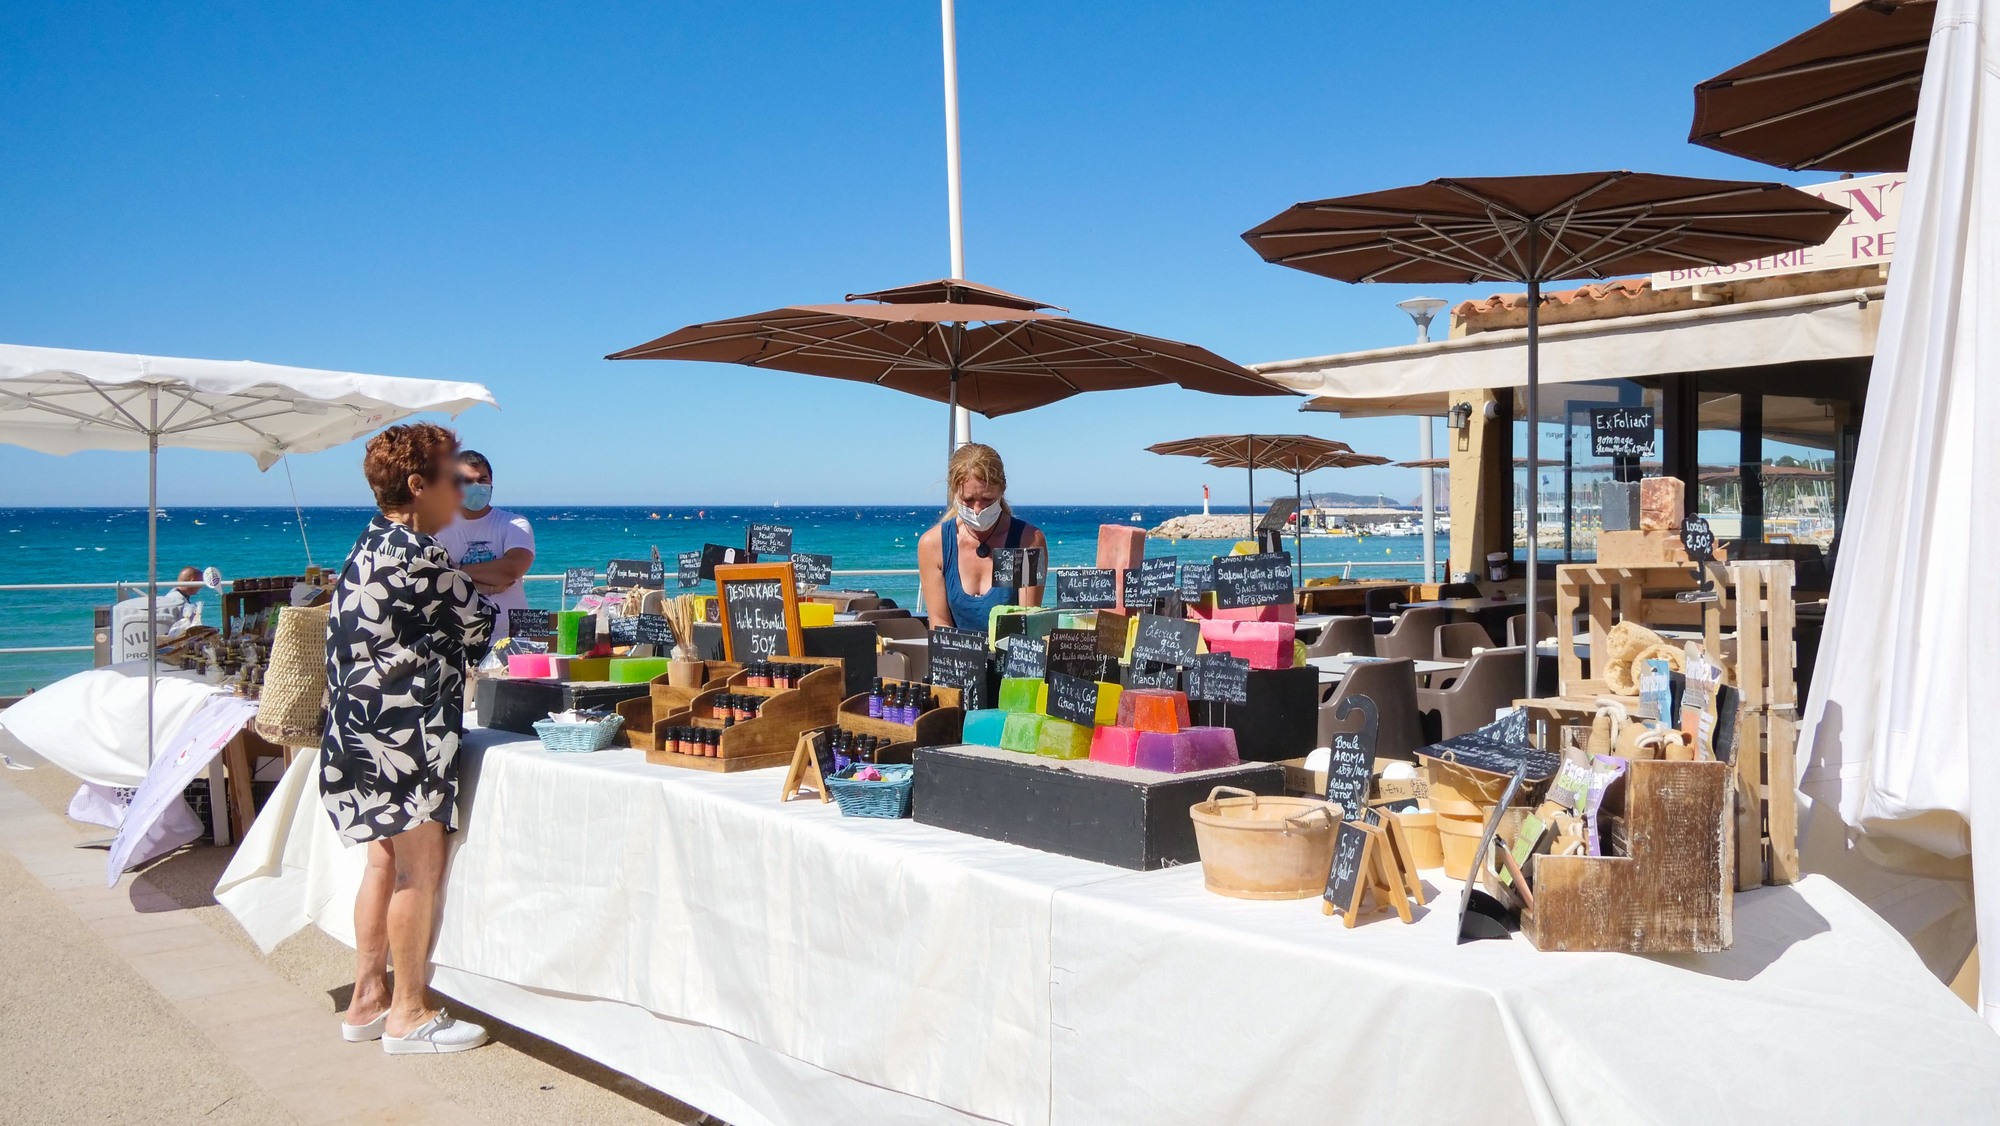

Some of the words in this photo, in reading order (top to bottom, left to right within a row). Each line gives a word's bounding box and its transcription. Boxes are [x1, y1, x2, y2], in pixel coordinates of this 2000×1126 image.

[1670, 247, 1814, 281] BRASSERIE
[727, 582, 784, 603] DESTOCKAGE
[1235, 583, 1257, 595] SANS
[735, 607, 753, 630] Huile
[750, 634, 777, 655] 50%
[1334, 735, 1360, 749] Boule
[1333, 750, 1365, 764] AROMA
